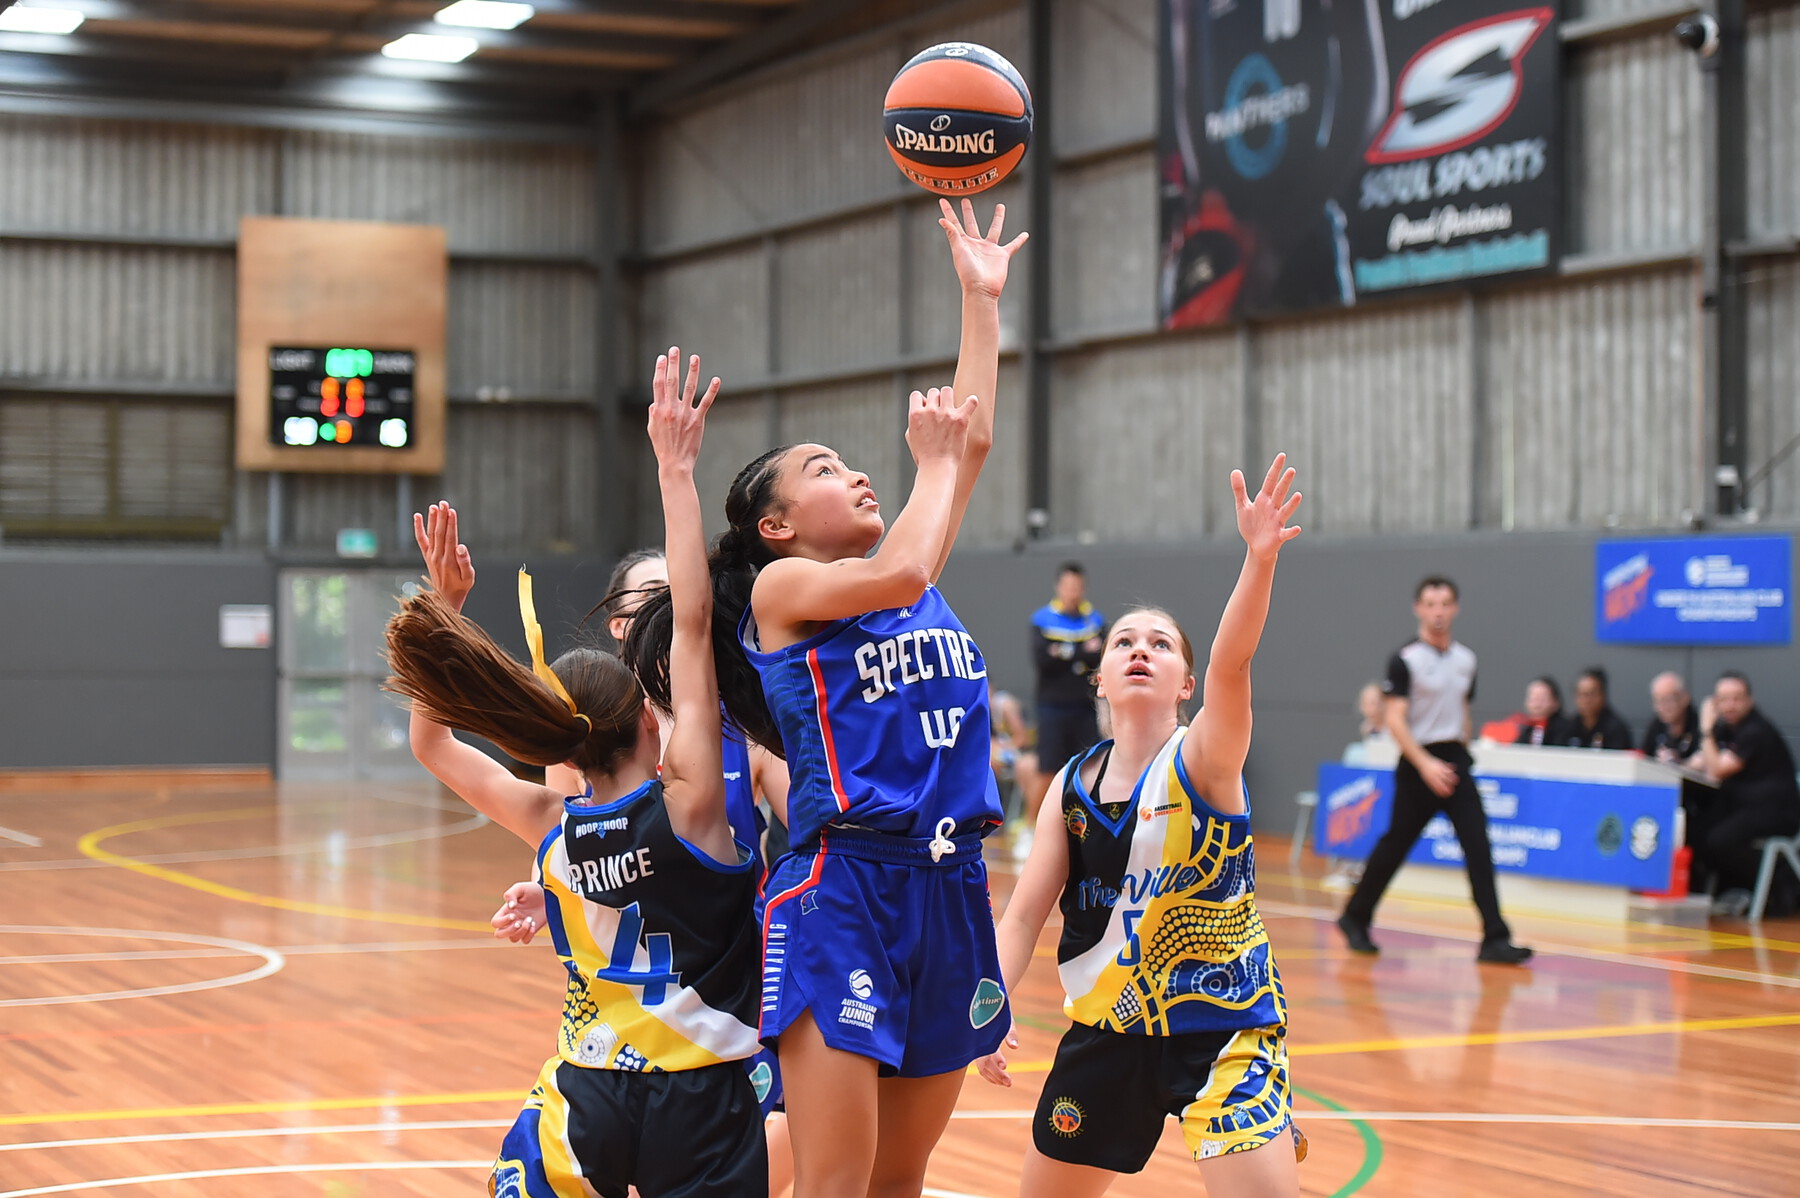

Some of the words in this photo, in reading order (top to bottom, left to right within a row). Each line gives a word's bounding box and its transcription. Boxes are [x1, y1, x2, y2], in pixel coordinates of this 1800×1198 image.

[895, 123, 995, 154] SPALDING
[1433, 137, 1547, 197] SPORTS
[1154, 801, 1182, 812] BASKETBALL
[568, 846, 655, 893] PRINCE
[1079, 877, 1121, 911] The
[1120, 862, 1198, 904] Ville
[595, 900, 683, 1006] 4
[762, 923, 788, 1013] NUNAWADING
[841, 998, 878, 1014] AUSTRALIAN
